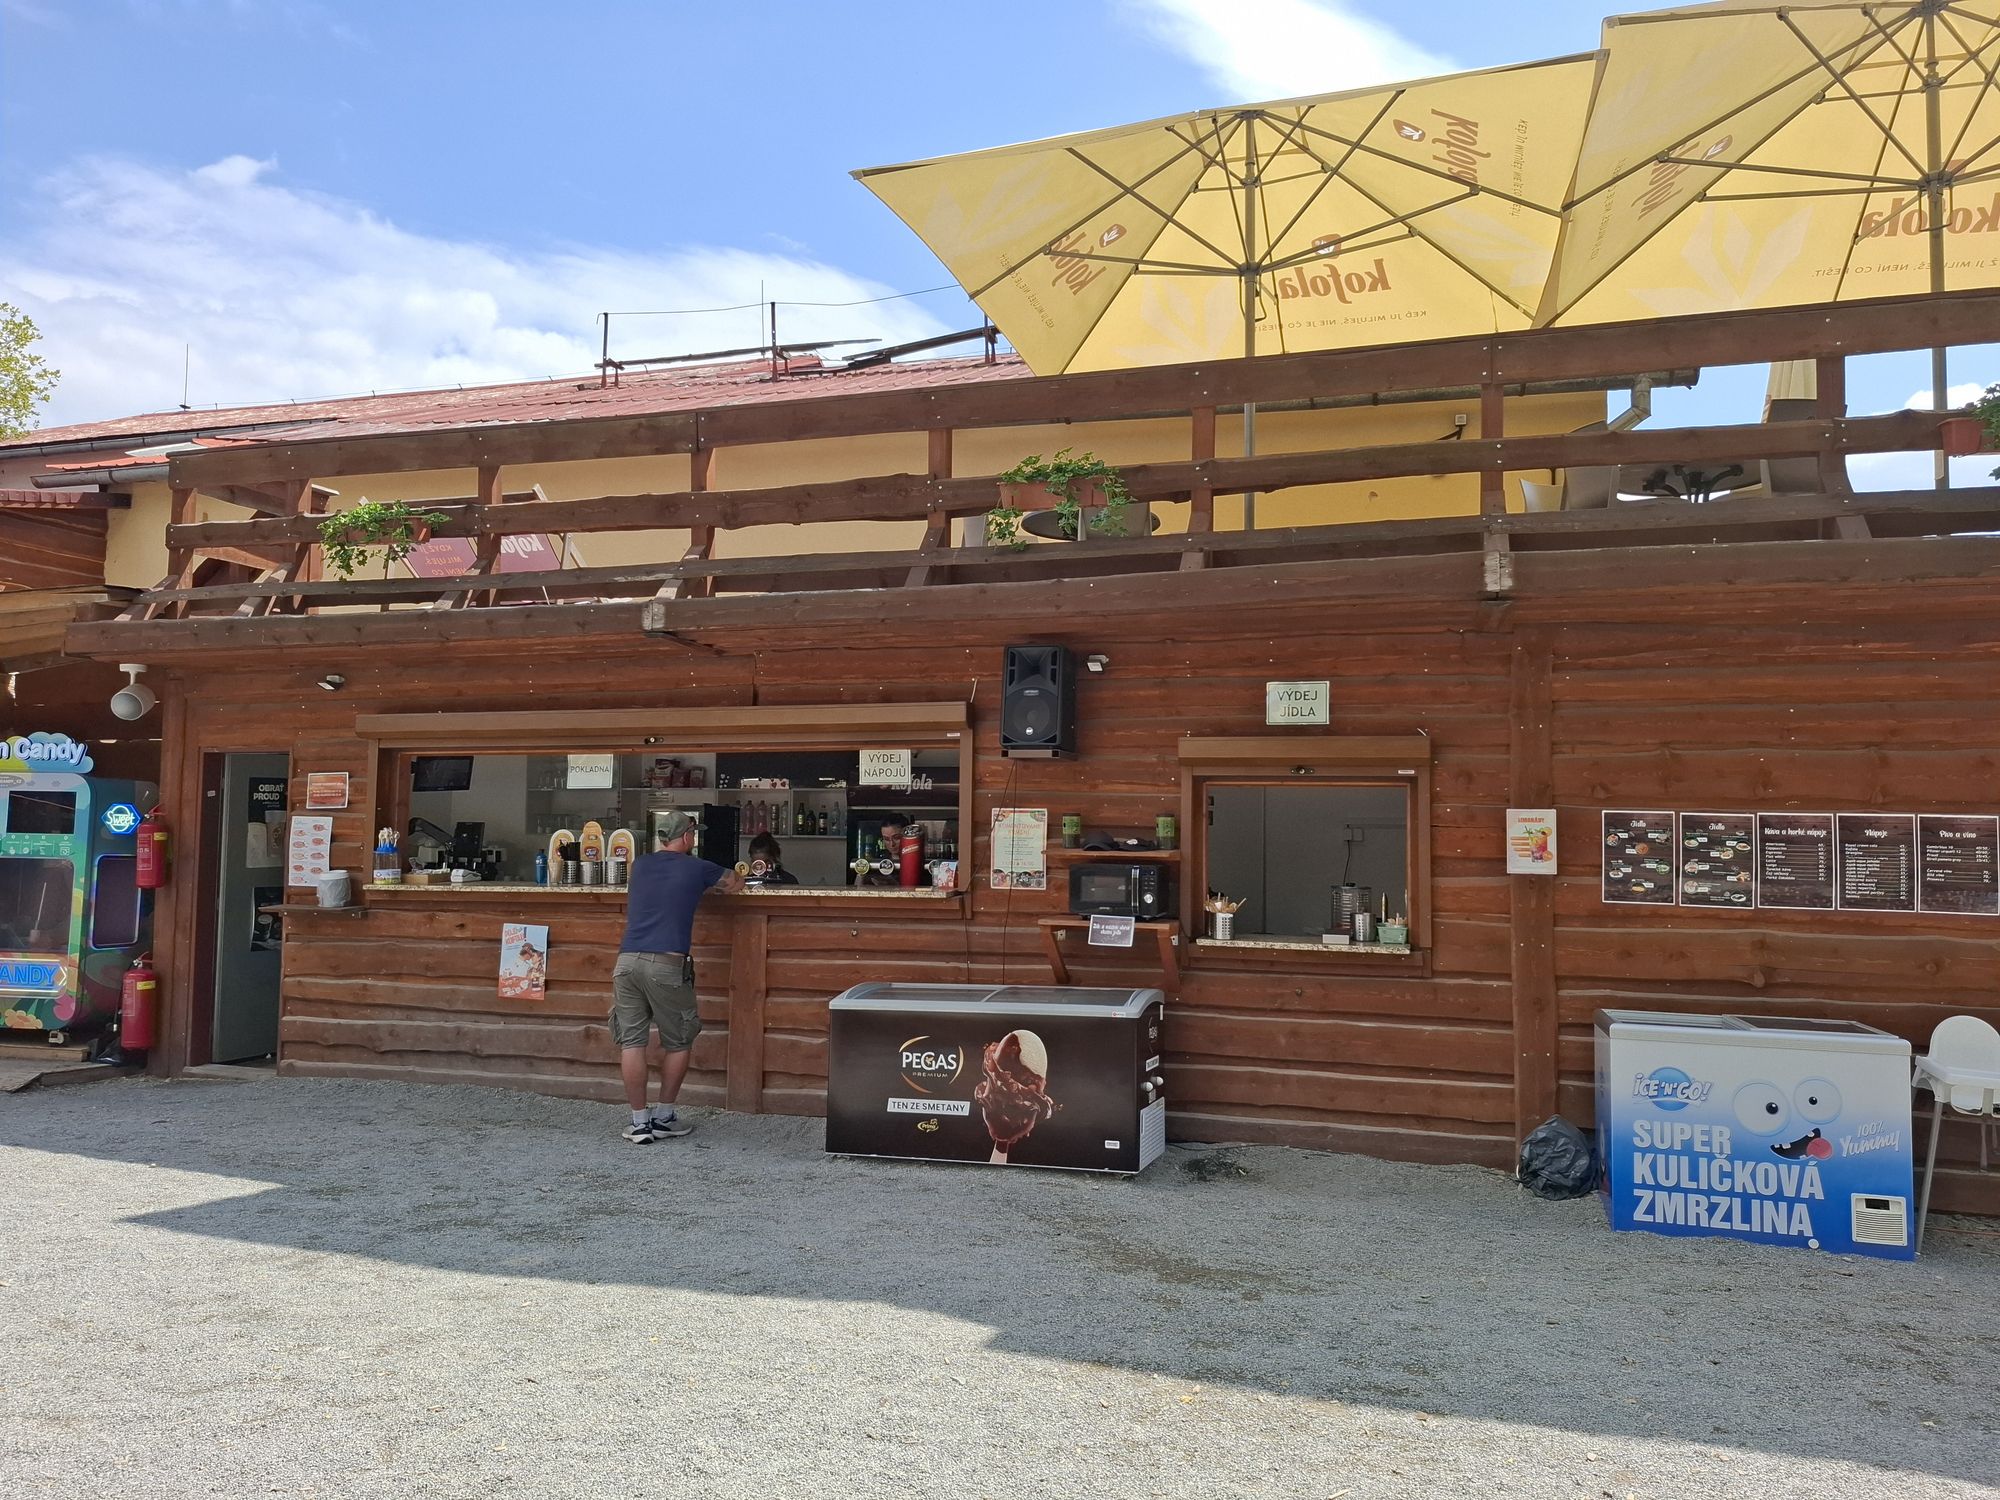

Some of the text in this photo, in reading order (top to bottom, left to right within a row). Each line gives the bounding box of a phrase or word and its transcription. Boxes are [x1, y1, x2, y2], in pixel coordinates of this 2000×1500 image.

[1277, 688, 1318, 701] VÝDEJ
[1280, 704, 1316, 717] JÍDLA
[14, 737, 86, 766] Candy
[868, 752, 902, 763] VÝDEJ
[864, 765, 906, 778] NÁPOJŮ
[253, 792, 280, 800] PROUD
[106, 810, 135, 826] Sweet
[1764, 827, 1780, 835] Káva
[1788, 828, 1806, 836] horké
[1806, 829, 1827, 838] nápoje
[1864, 828, 1888, 838] Nápoje
[1939, 830, 1954, 838] Pivo
[0, 964, 57, 985] ANDY
[902, 1051, 958, 1071] PEGAS
[892, 1101, 966, 1112] TEN ZE SMETANY
[1857, 1120, 1885, 1137] 100%
[1632, 1119, 1732, 1154] SUPER
[1839, 1130, 1900, 1157] Yummy
[1633, 1152, 1825, 1200] KULIČKOVÁ
[1633, 1188, 1814, 1237] ZMRZLINA
